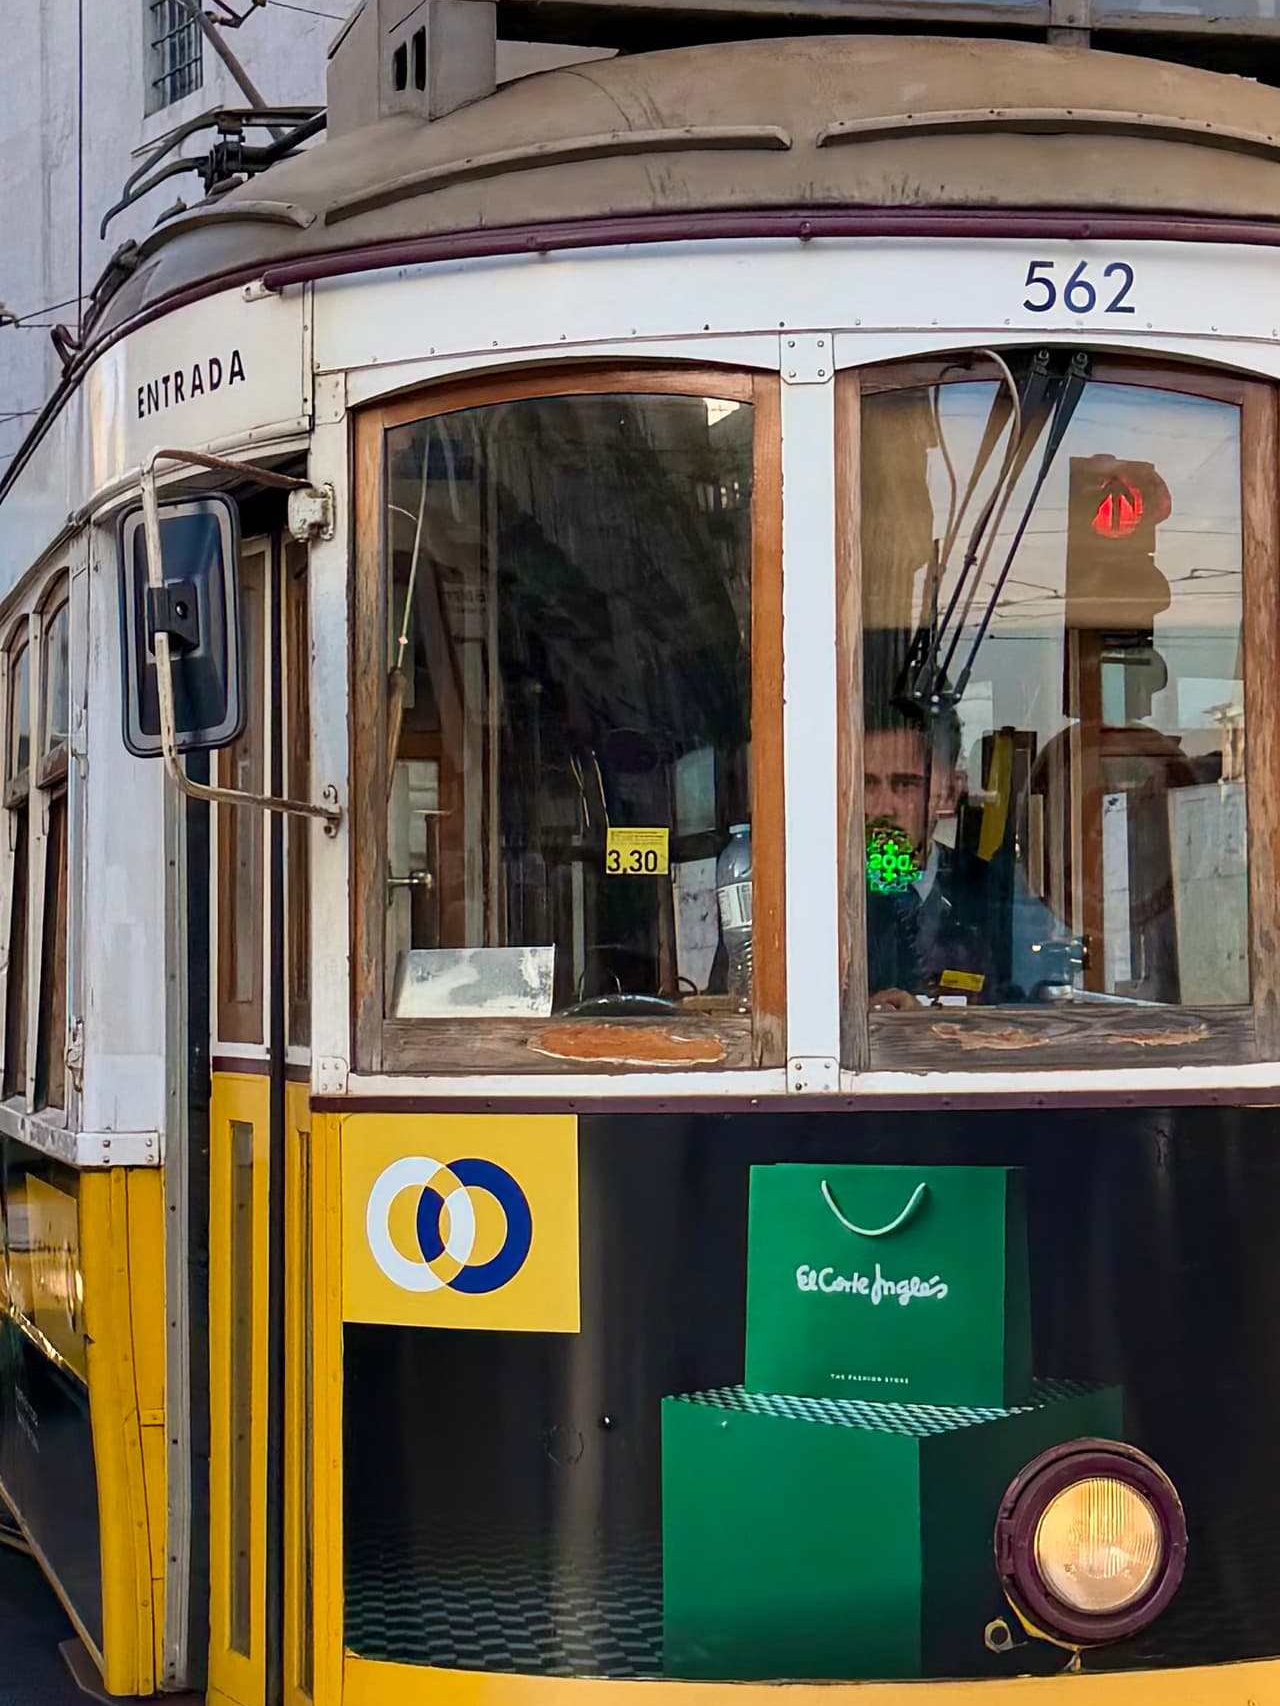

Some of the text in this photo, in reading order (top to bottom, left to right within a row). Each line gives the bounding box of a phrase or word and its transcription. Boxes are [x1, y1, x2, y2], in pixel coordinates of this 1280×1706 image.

[1022, 260, 1136, 314] 562
[137, 349, 246, 419] ENTRADA
[796, 1263, 948, 1306] El Corte Inglés
